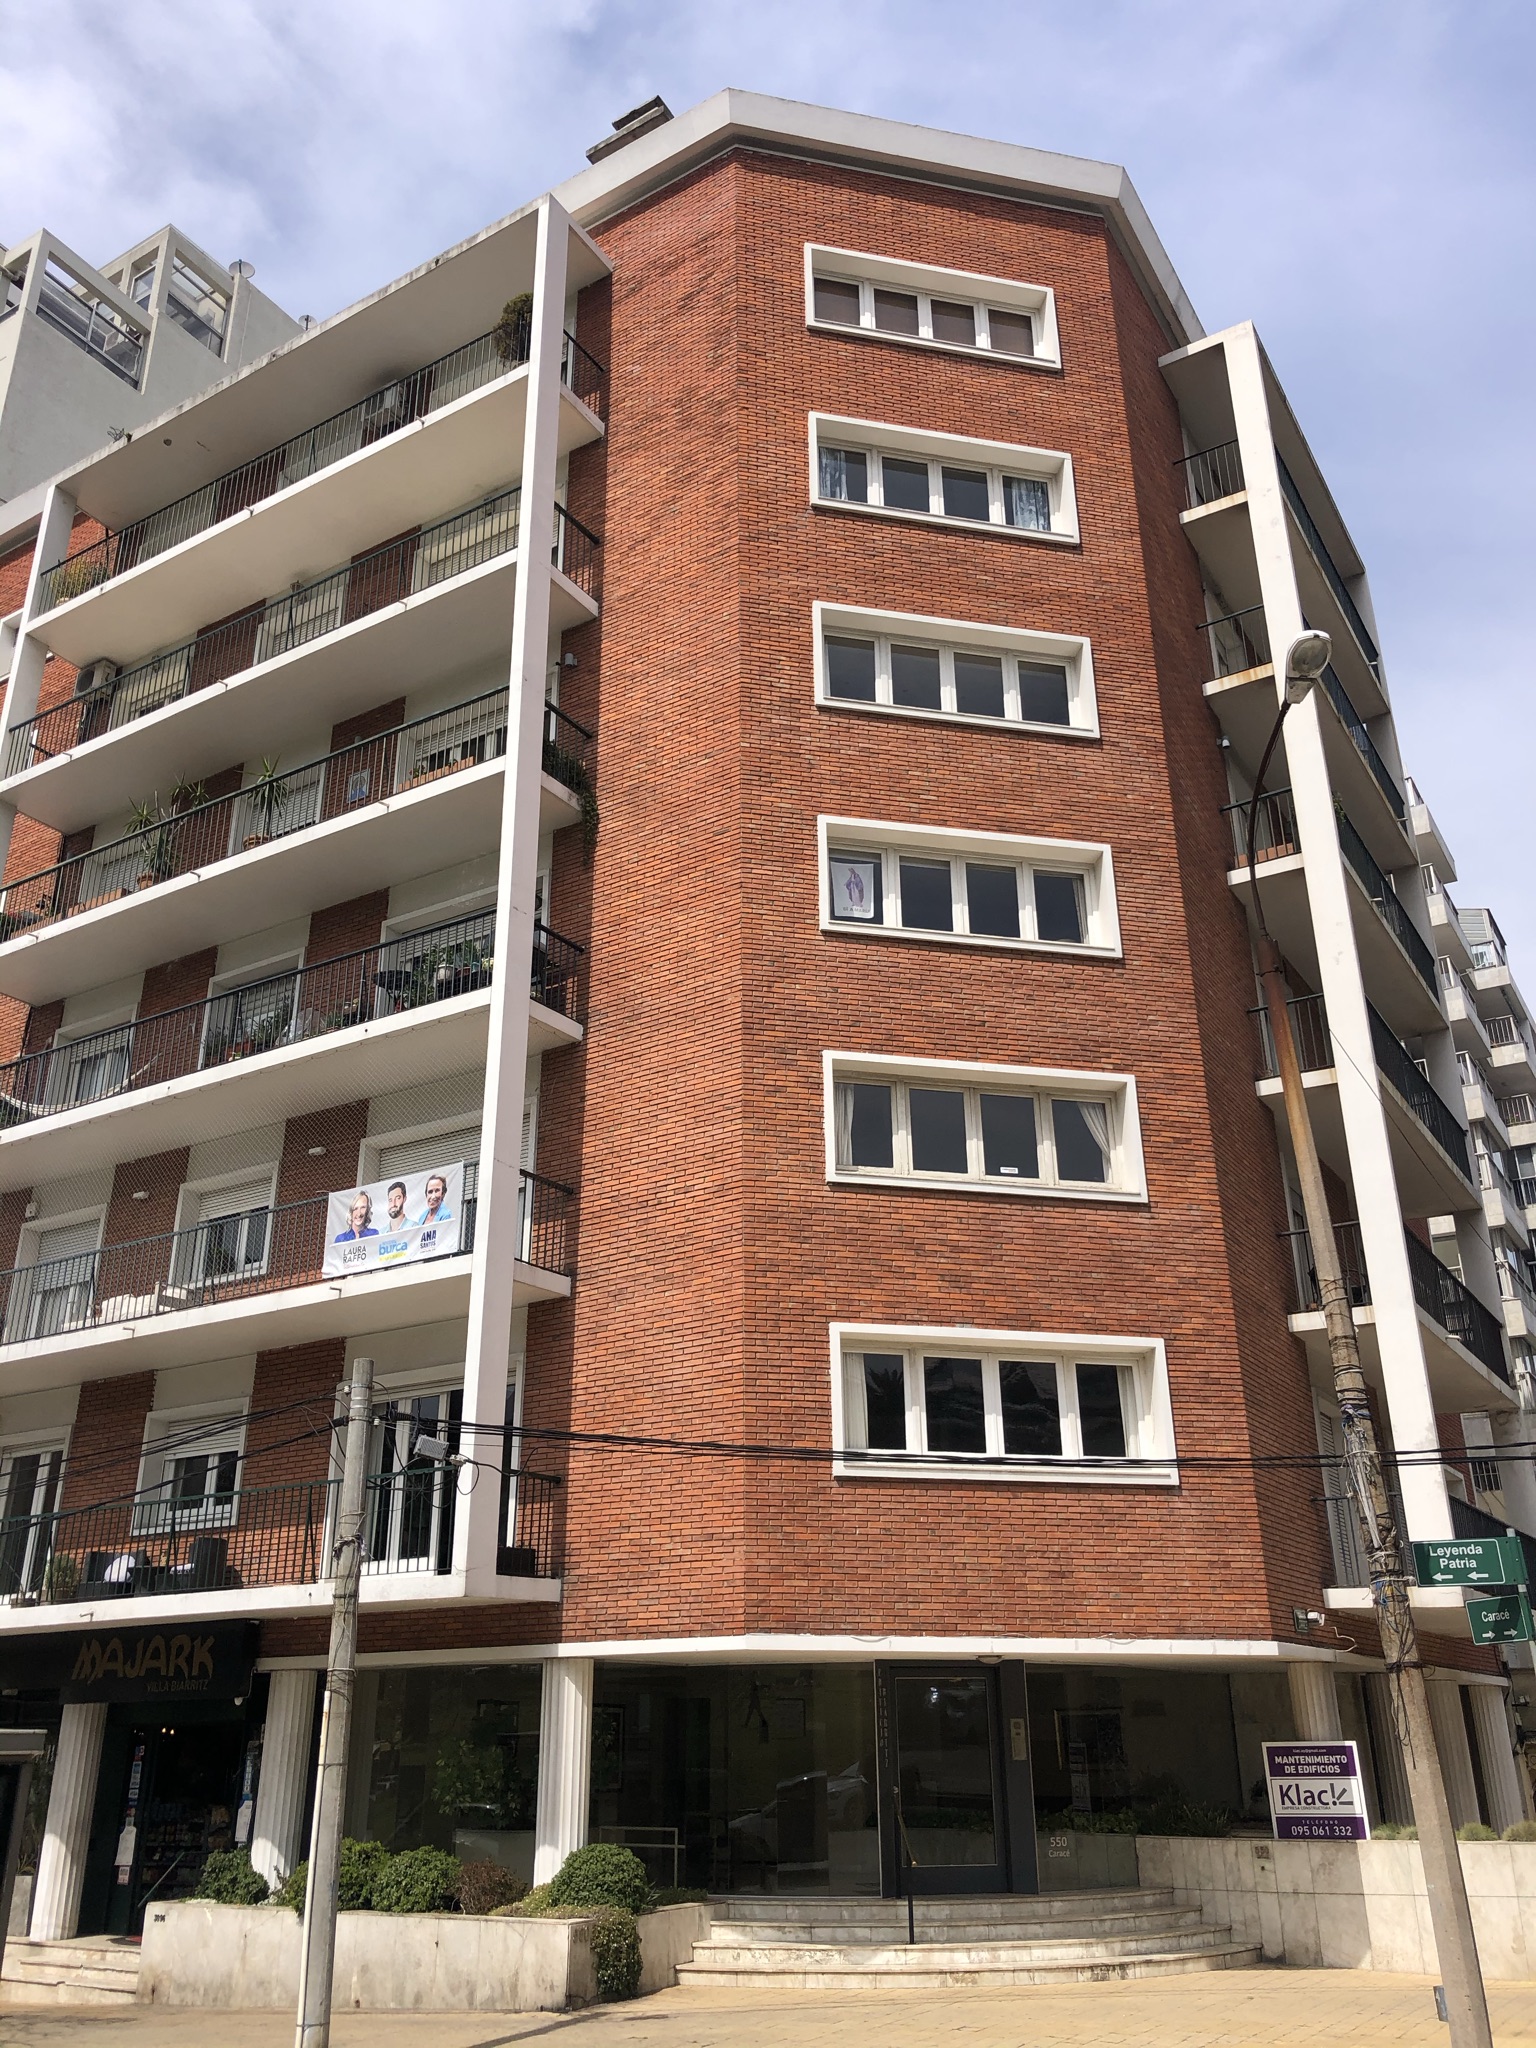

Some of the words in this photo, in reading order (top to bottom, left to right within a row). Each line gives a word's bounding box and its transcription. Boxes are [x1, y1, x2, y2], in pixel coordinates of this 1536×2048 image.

[420, 1230, 436, 1242] ANA
[343, 1245, 366, 1256] LAURA
[343, 1252, 366, 1264] RAFFO
[1429, 1544, 1483, 1558] Leyenda
[1440, 1558, 1477, 1569] Patria
[1482, 1609, 1510, 1622] Caracé
[72, 1634, 216, 1684] MAJARK
[147, 1681, 169, 1692] VILLA
[170, 1680, 209, 1692] BIARRITZ
[1275, 1755, 1347, 1764] MANTENIMIENTO
[1284, 1765, 1296, 1773] DE
[1298, 1765, 1340, 1773] EDIFICIOS
[1291, 1826, 1310, 1836] 095
[1312, 1826, 1330, 1836] 061
[1334, 1826, 1352, 1836] 332
[1050, 1837, 1068, 1847] 550
[1048, 1849, 1070, 1858] Caracé
